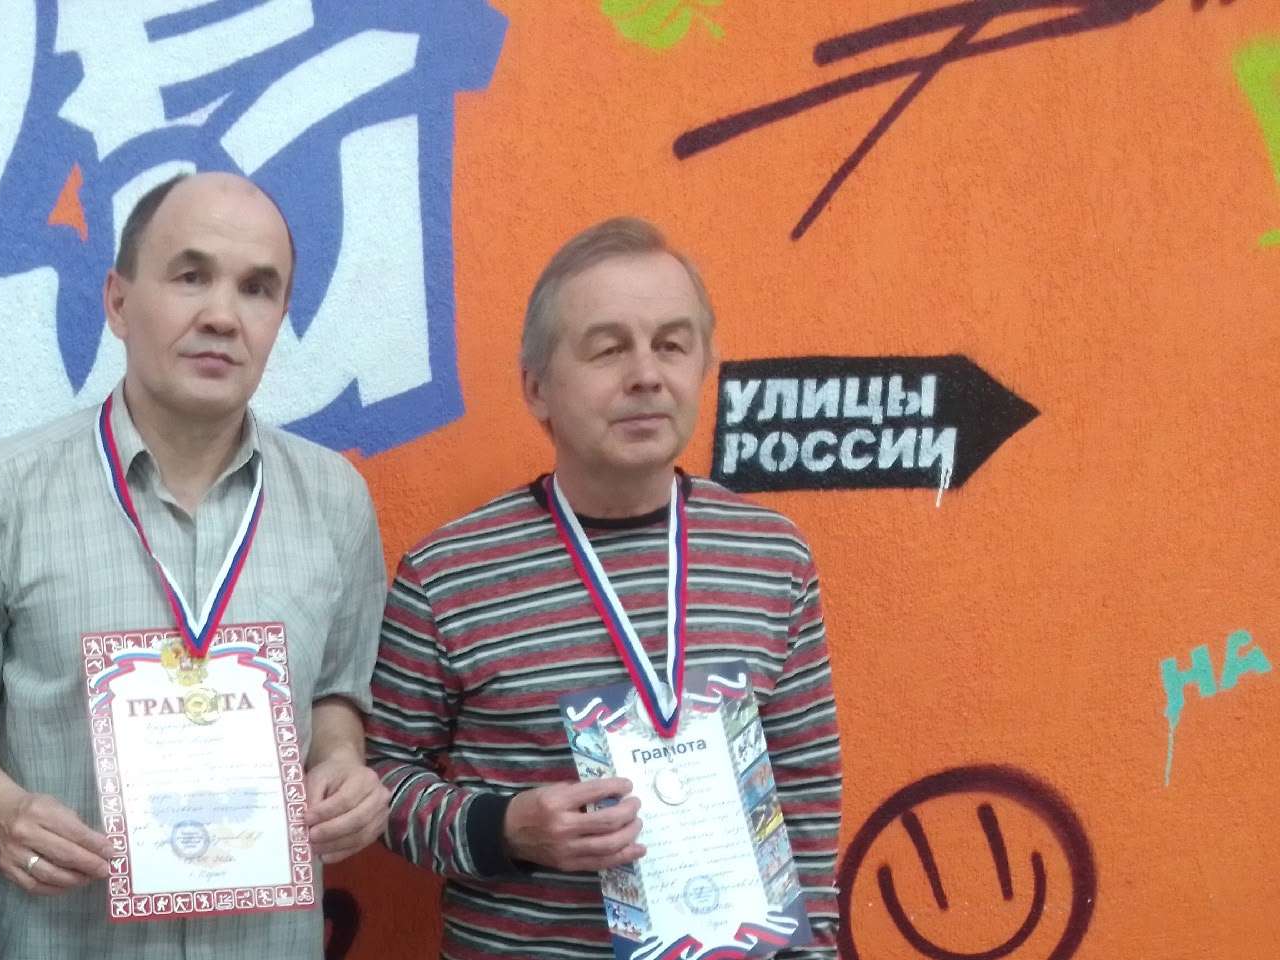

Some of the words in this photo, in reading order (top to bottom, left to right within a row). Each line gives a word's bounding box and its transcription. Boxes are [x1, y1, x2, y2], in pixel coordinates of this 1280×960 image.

[723, 375, 937, 425] УЛИЦЫ
[722, 427, 958, 475] РОССИИ
[126, 692, 255, 717] ГРАТА
